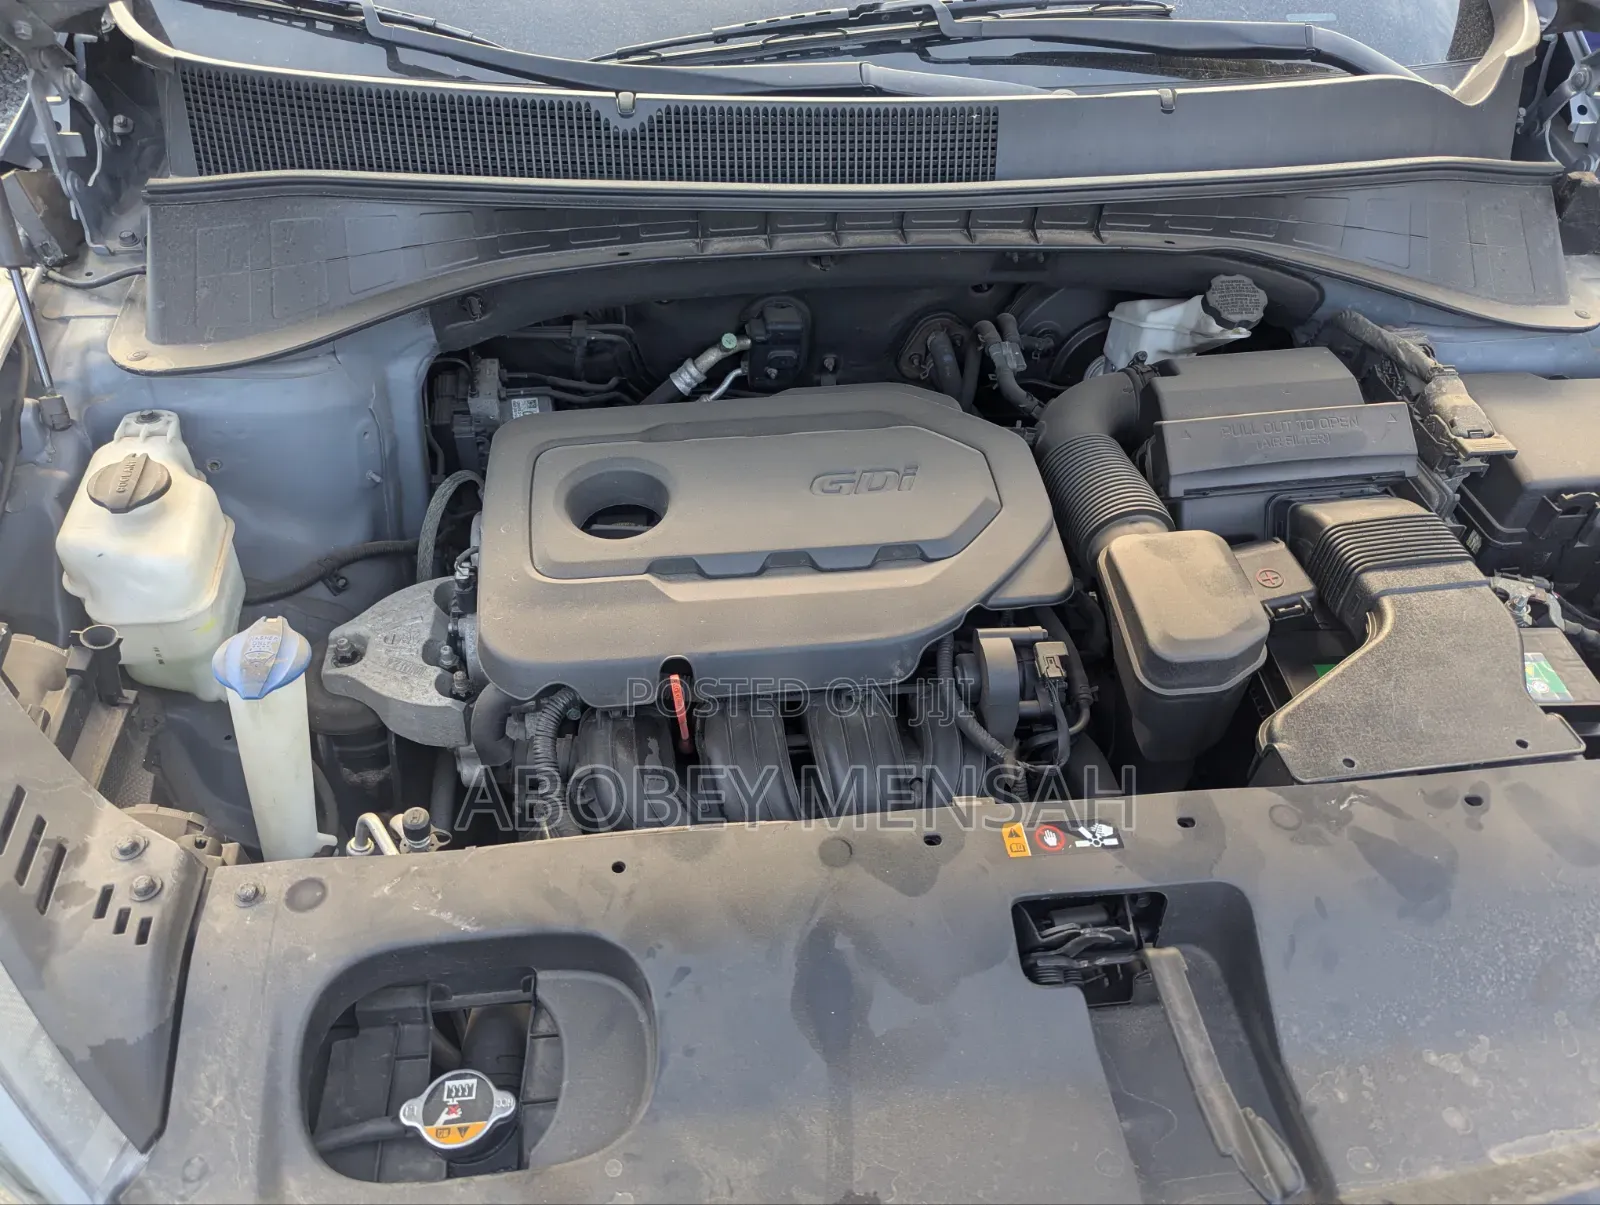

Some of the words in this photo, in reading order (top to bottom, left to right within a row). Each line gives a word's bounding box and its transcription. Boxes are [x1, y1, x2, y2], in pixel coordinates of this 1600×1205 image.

[1221, 423, 1259, 439] PULL
[1263, 421, 1292, 435] OUT
[1295, 419, 1316, 431] TO
[1319, 415, 1359, 431] OPEN
[116, 460, 137, 493] COOLANT
